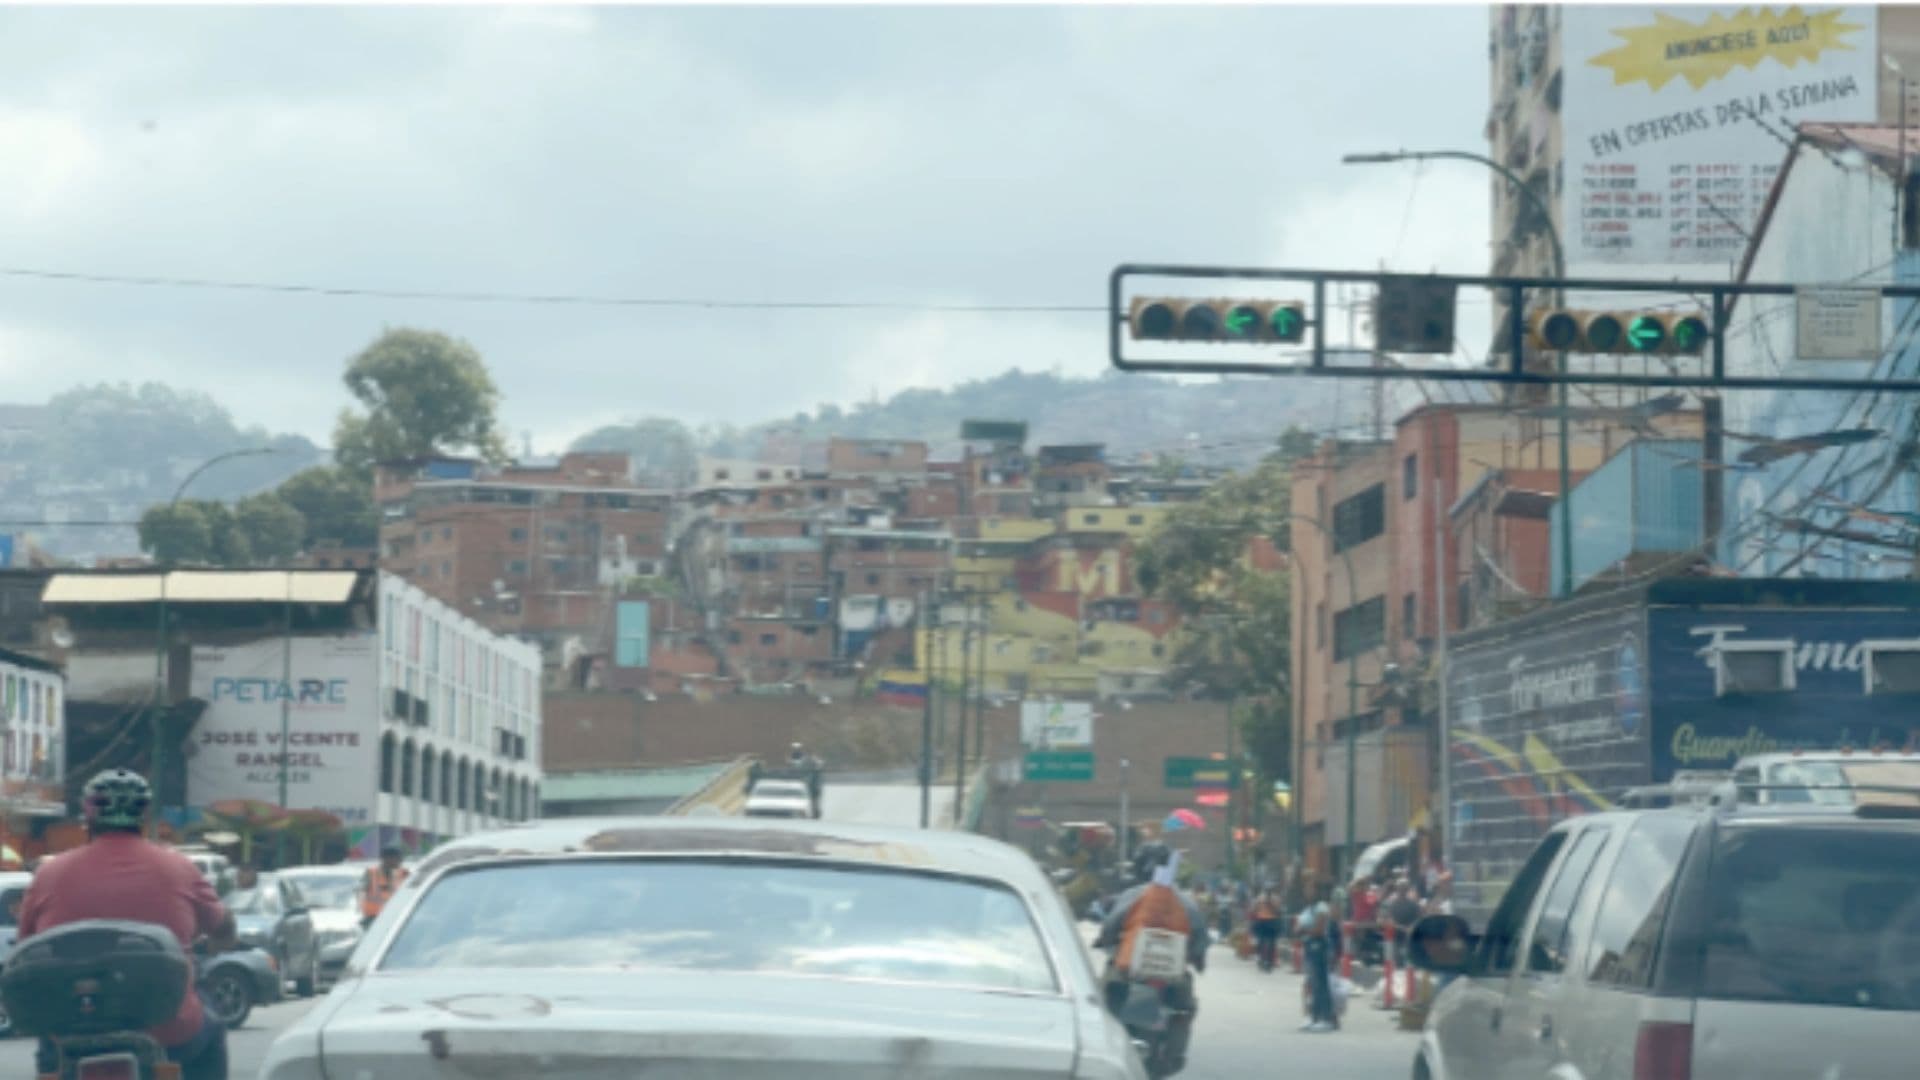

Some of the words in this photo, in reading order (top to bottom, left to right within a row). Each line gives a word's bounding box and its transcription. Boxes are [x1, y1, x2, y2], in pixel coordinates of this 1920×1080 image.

[1589, 128, 1622, 157] EN
[1625, 105, 1710, 147] OFERTAS
[1776, 75, 1858, 110] SEMANA
[212, 676, 348, 703] PETARE
[265, 732, 360, 746] VCENTE
[236, 753, 325, 768] RANGEL
